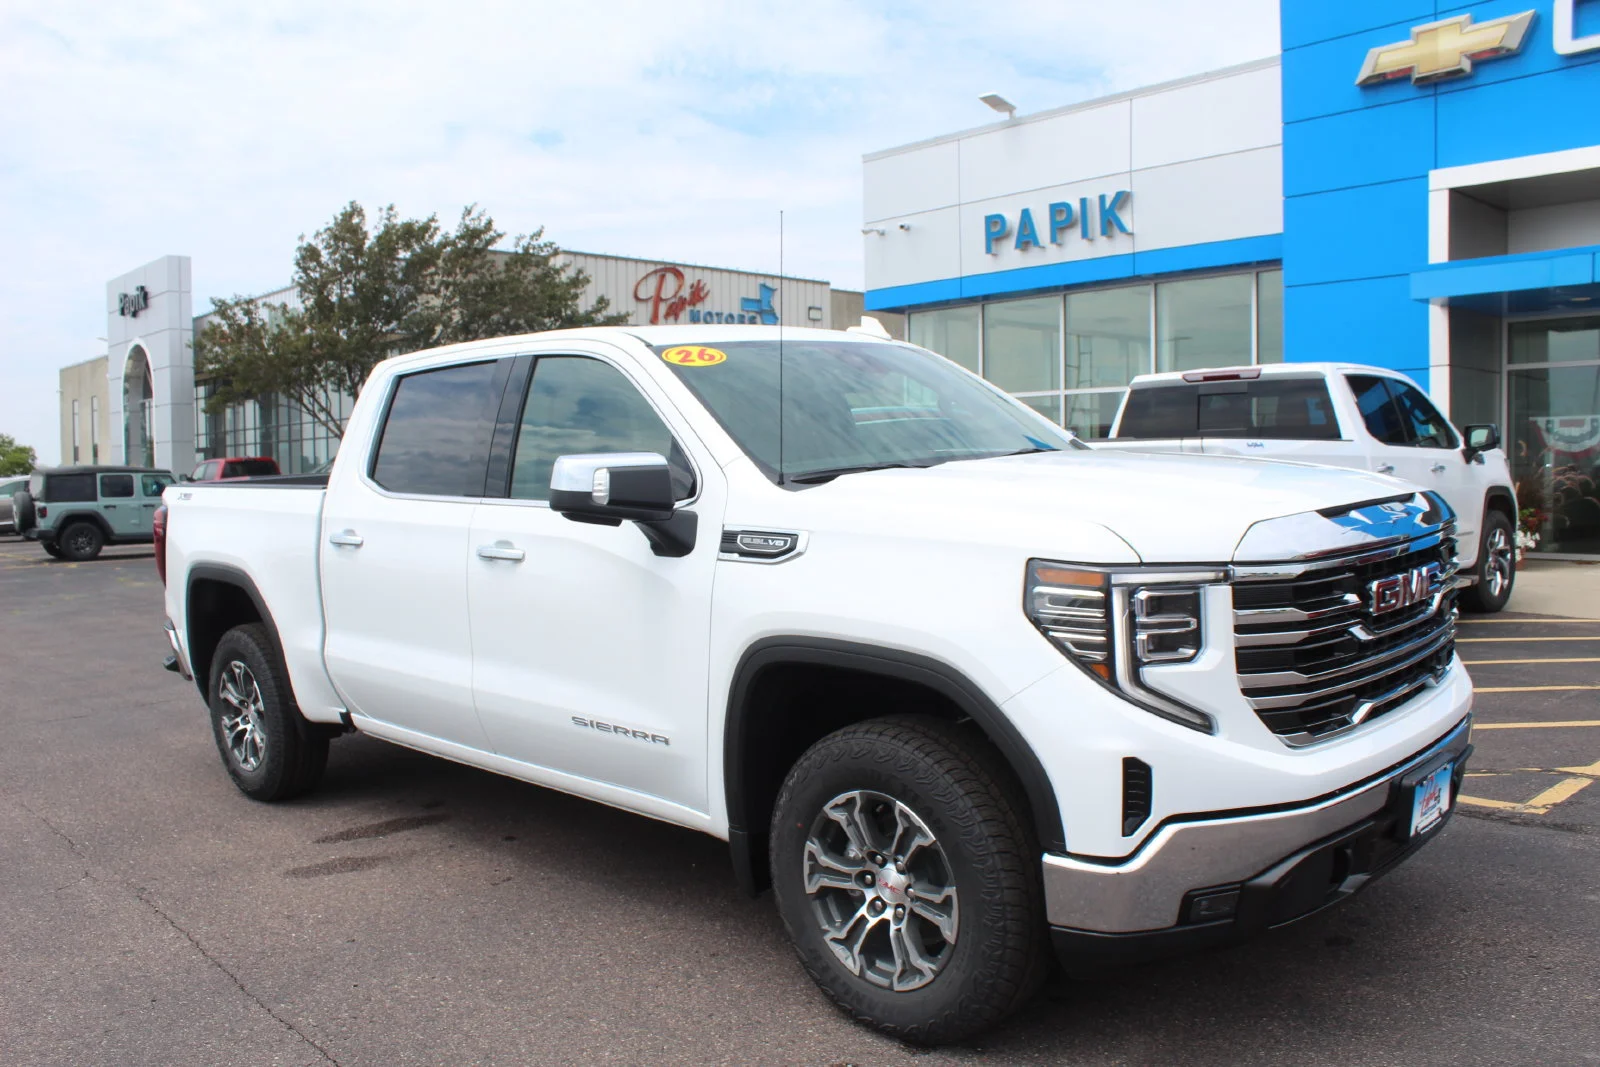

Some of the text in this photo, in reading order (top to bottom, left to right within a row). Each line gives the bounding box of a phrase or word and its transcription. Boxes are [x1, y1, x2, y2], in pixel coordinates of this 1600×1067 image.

[985, 190, 1134, 256] PAPIK
[119, 285, 148, 318] Papik
[689, 309, 758, 324] MOTORS
[675, 348, 716, 363] 26
[1371, 561, 1441, 616] GMC
[571, 715, 671, 746] SIERRA
